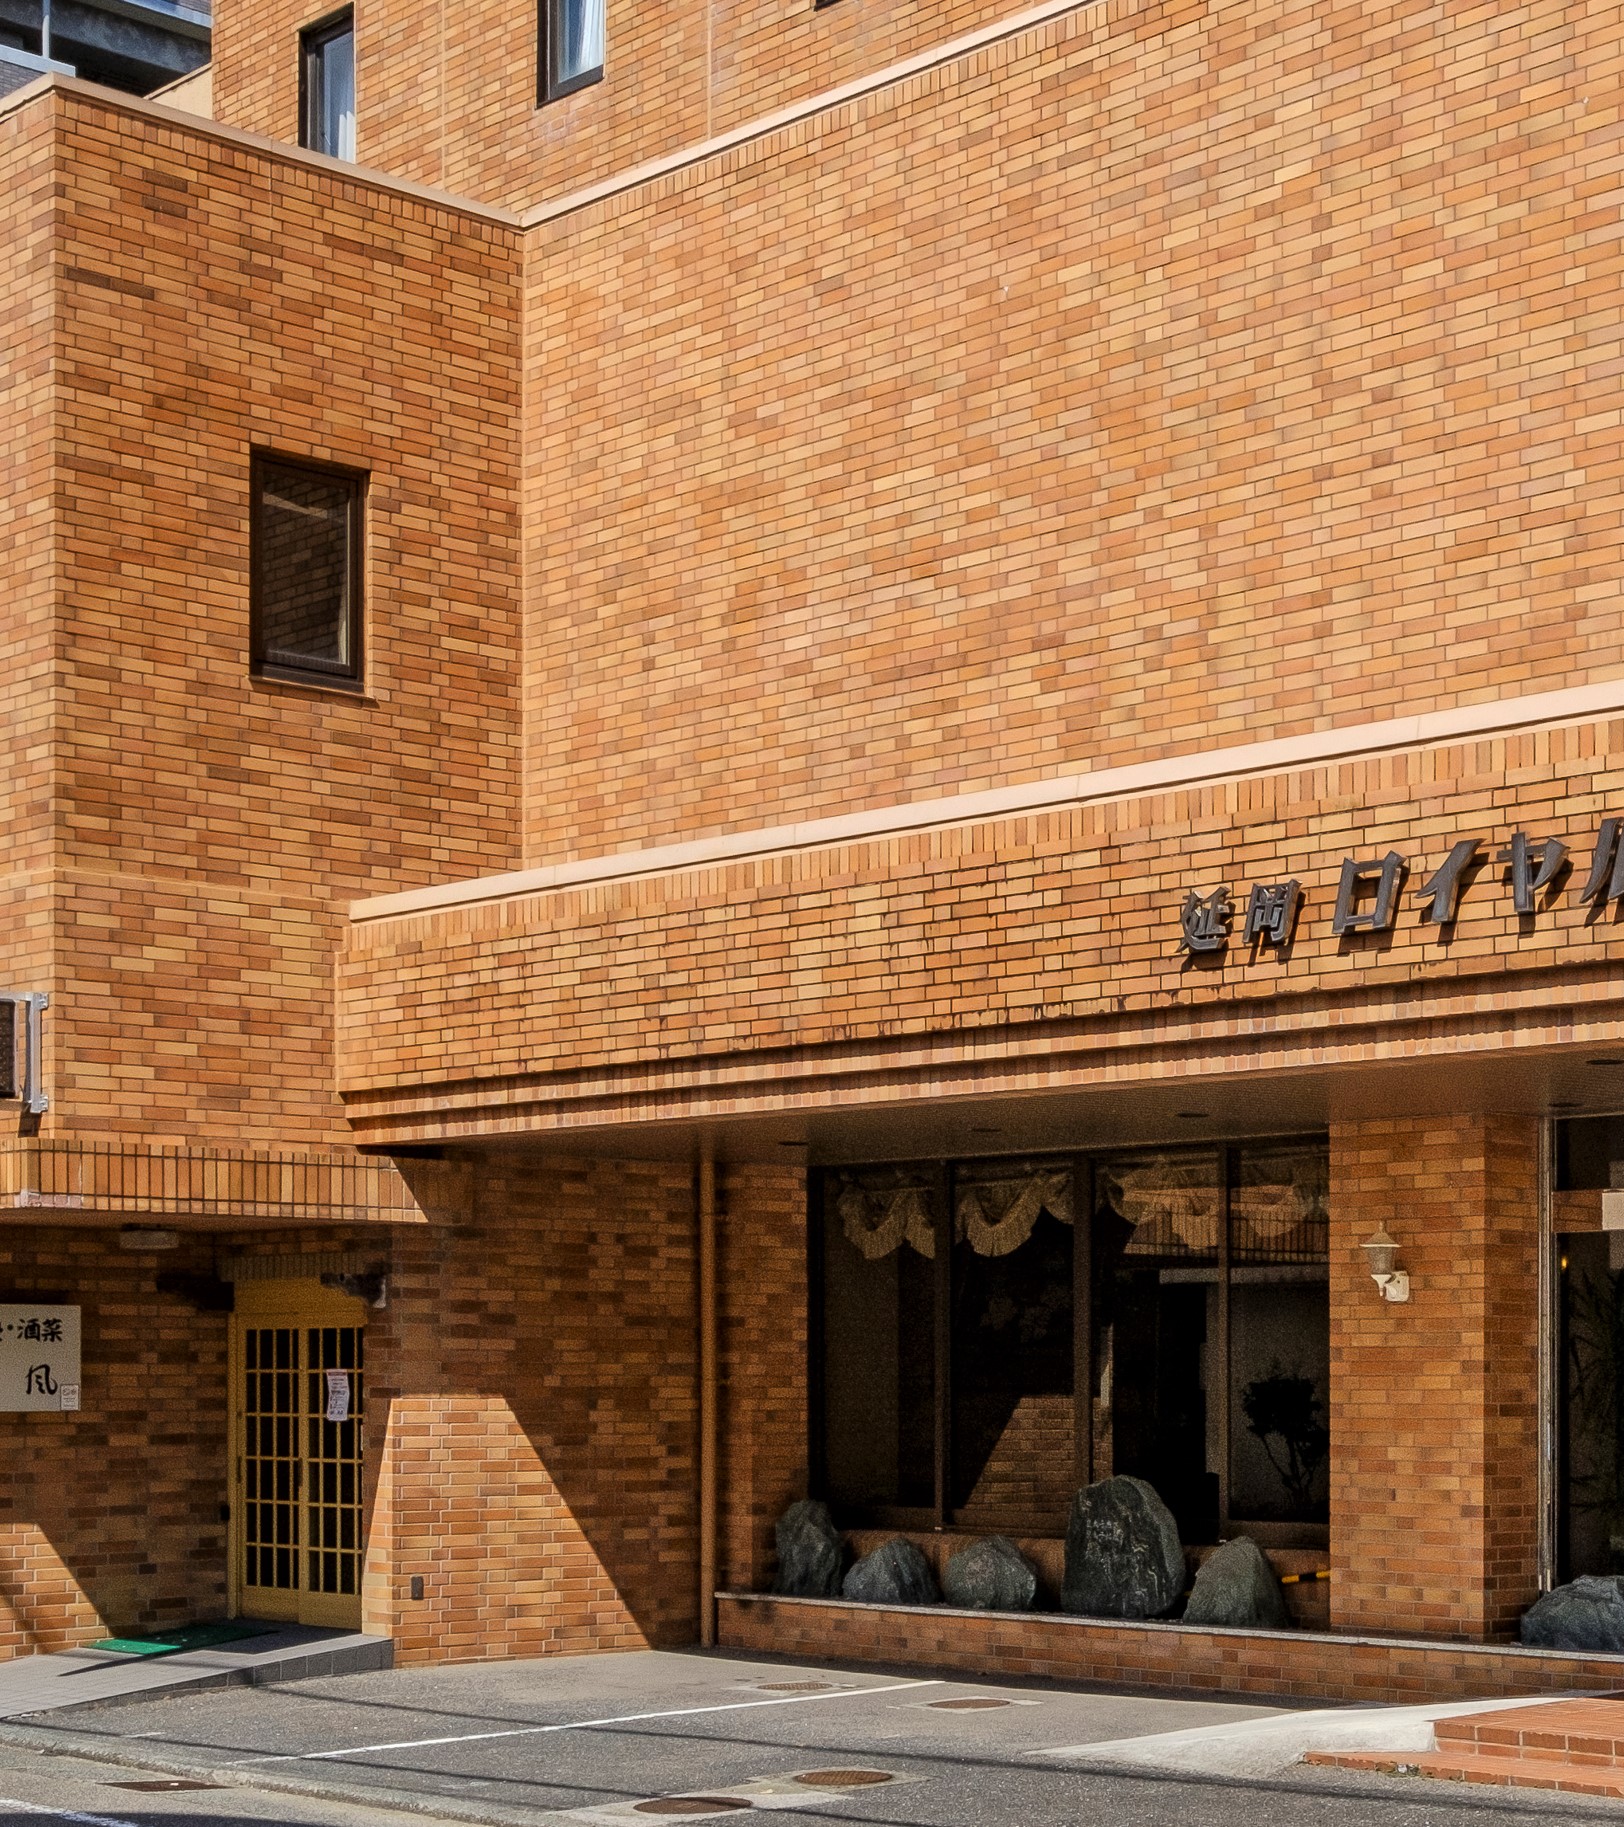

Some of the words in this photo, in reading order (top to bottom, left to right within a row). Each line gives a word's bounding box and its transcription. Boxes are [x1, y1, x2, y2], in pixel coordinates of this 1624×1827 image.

[1176, 879, 1301, 950] 延岡
[0, 1318, 63, 1342] ・酒菜
